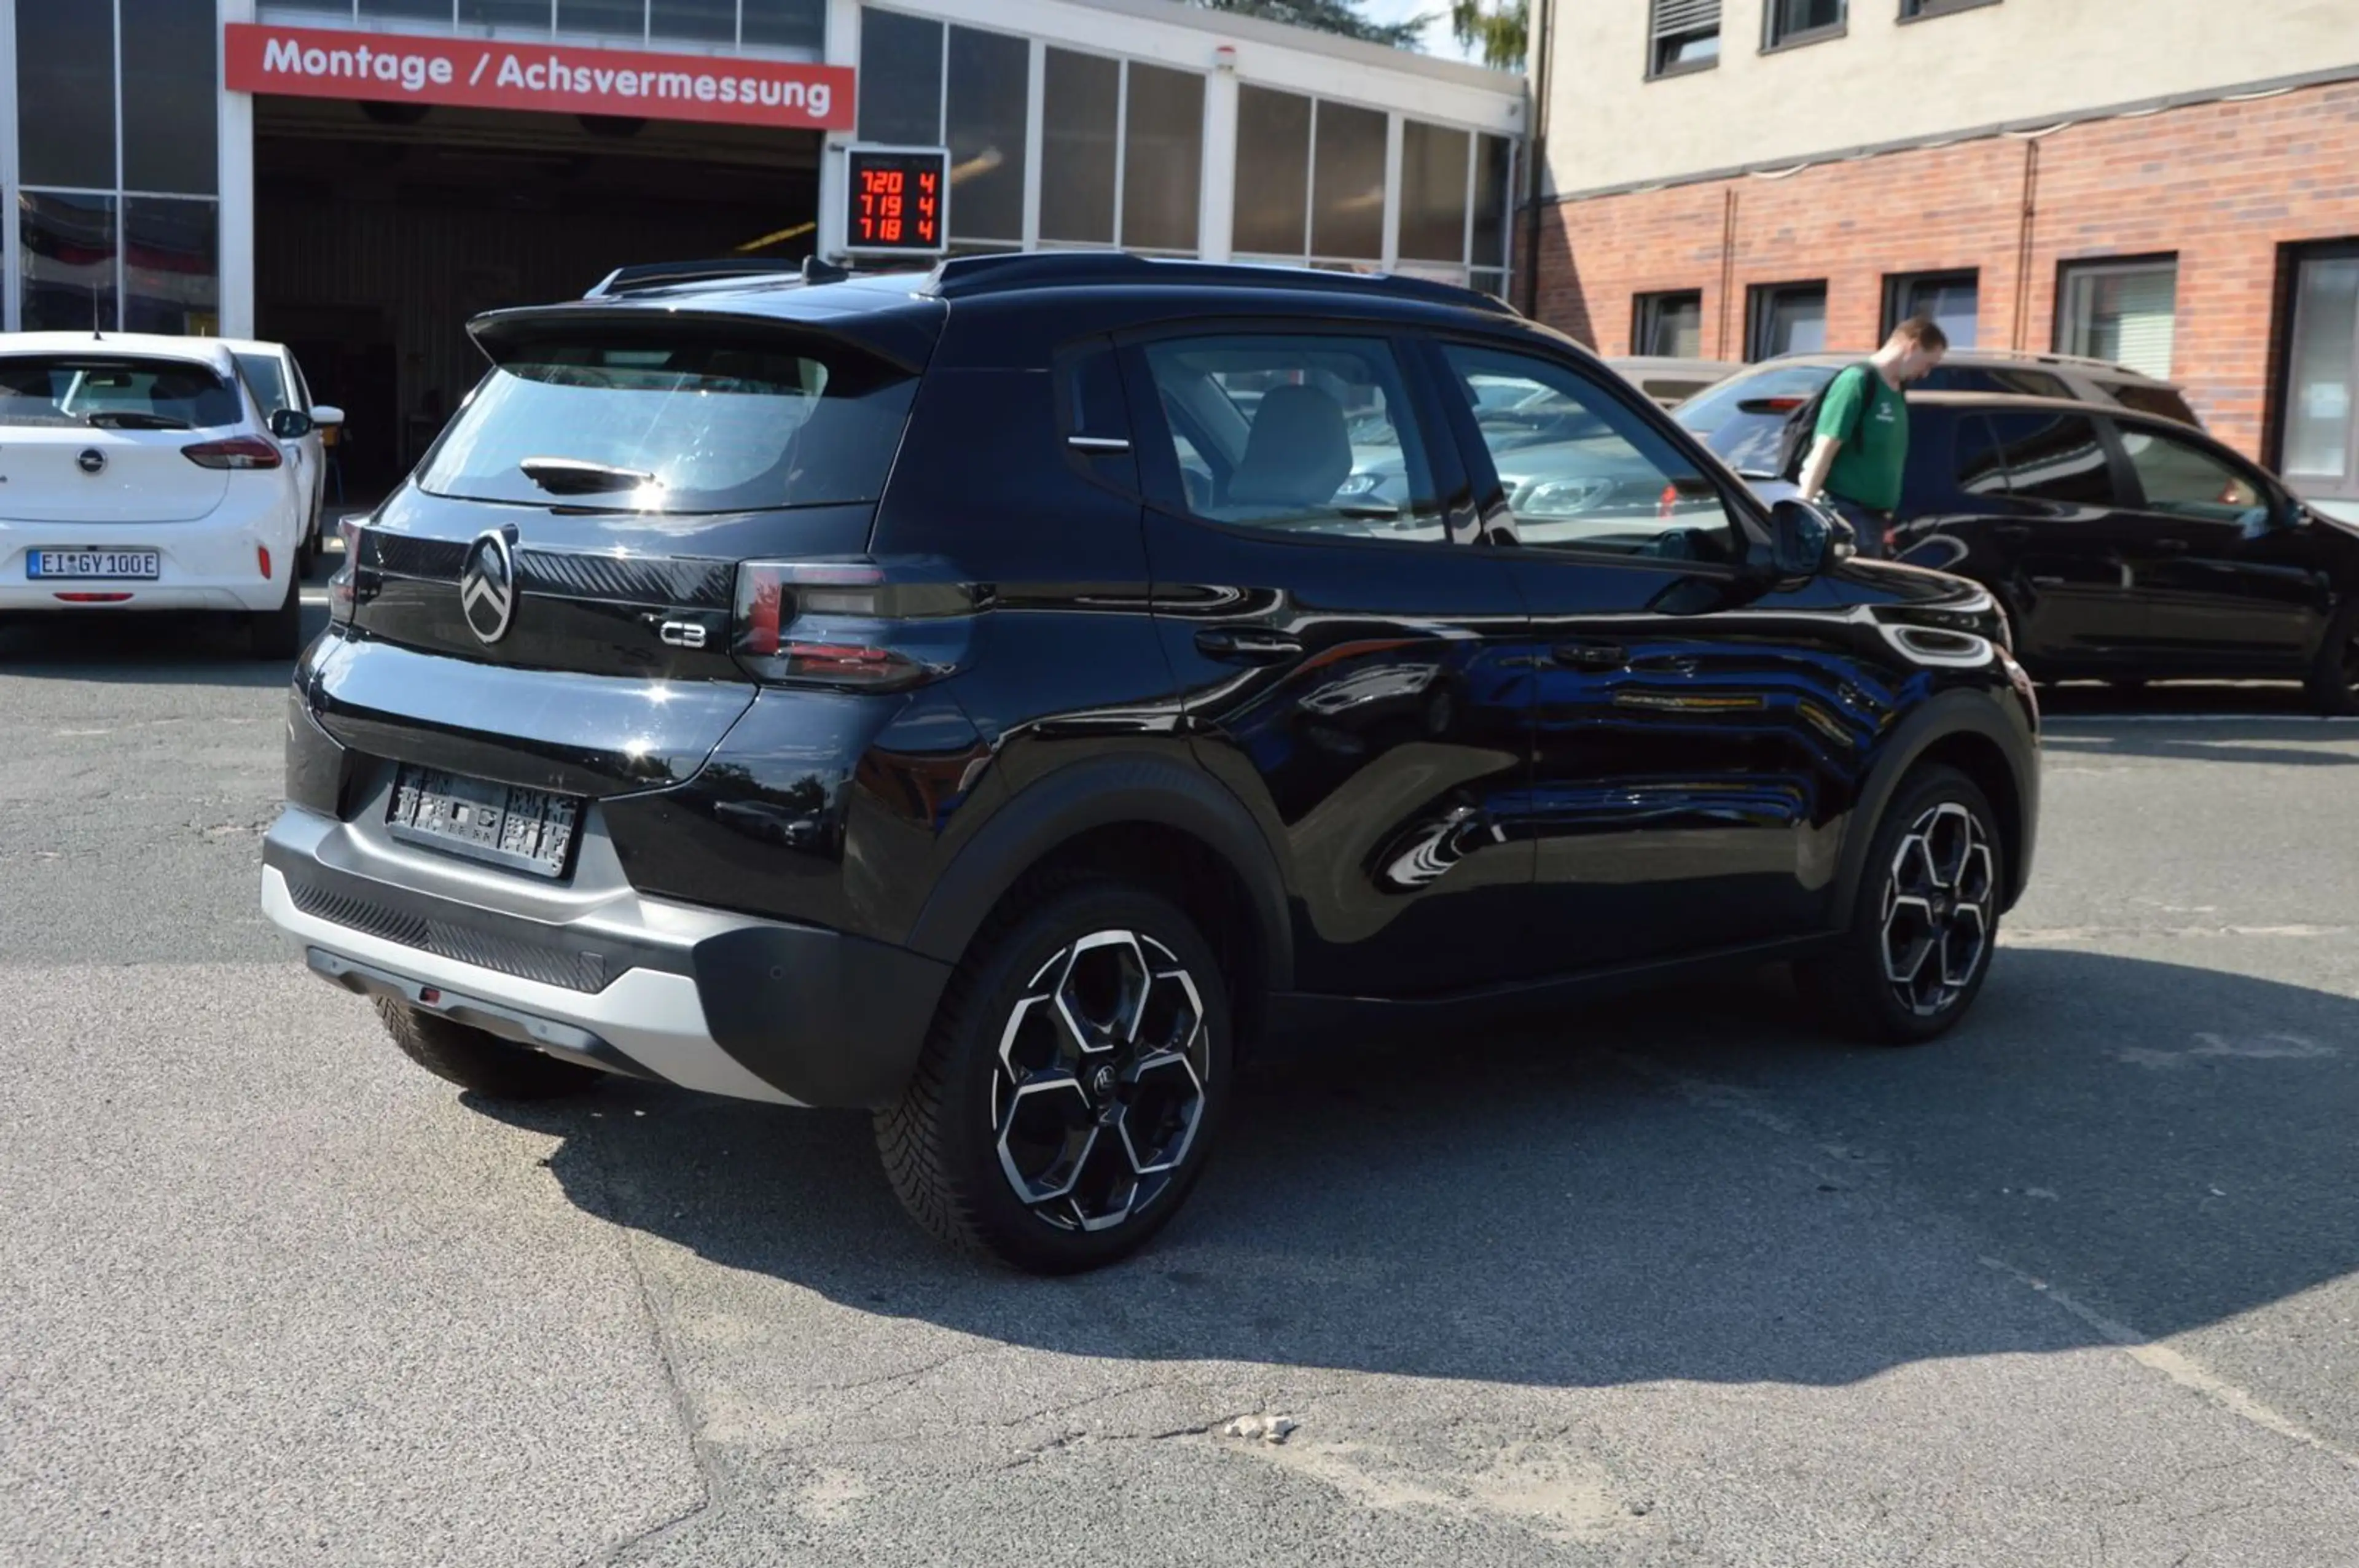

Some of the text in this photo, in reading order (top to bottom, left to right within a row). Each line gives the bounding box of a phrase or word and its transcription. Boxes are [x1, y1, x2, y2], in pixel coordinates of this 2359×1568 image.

[263, 37, 831, 117] Montage / Achsvermessung
[861, 171, 935, 194] 720 4
[861, 195, 934, 217] 719 4
[860, 218, 933, 241] 718 4
[42, 554, 65, 572] EI
[79, 554, 103, 573] GY
[660, 620, 706, 648] C3
